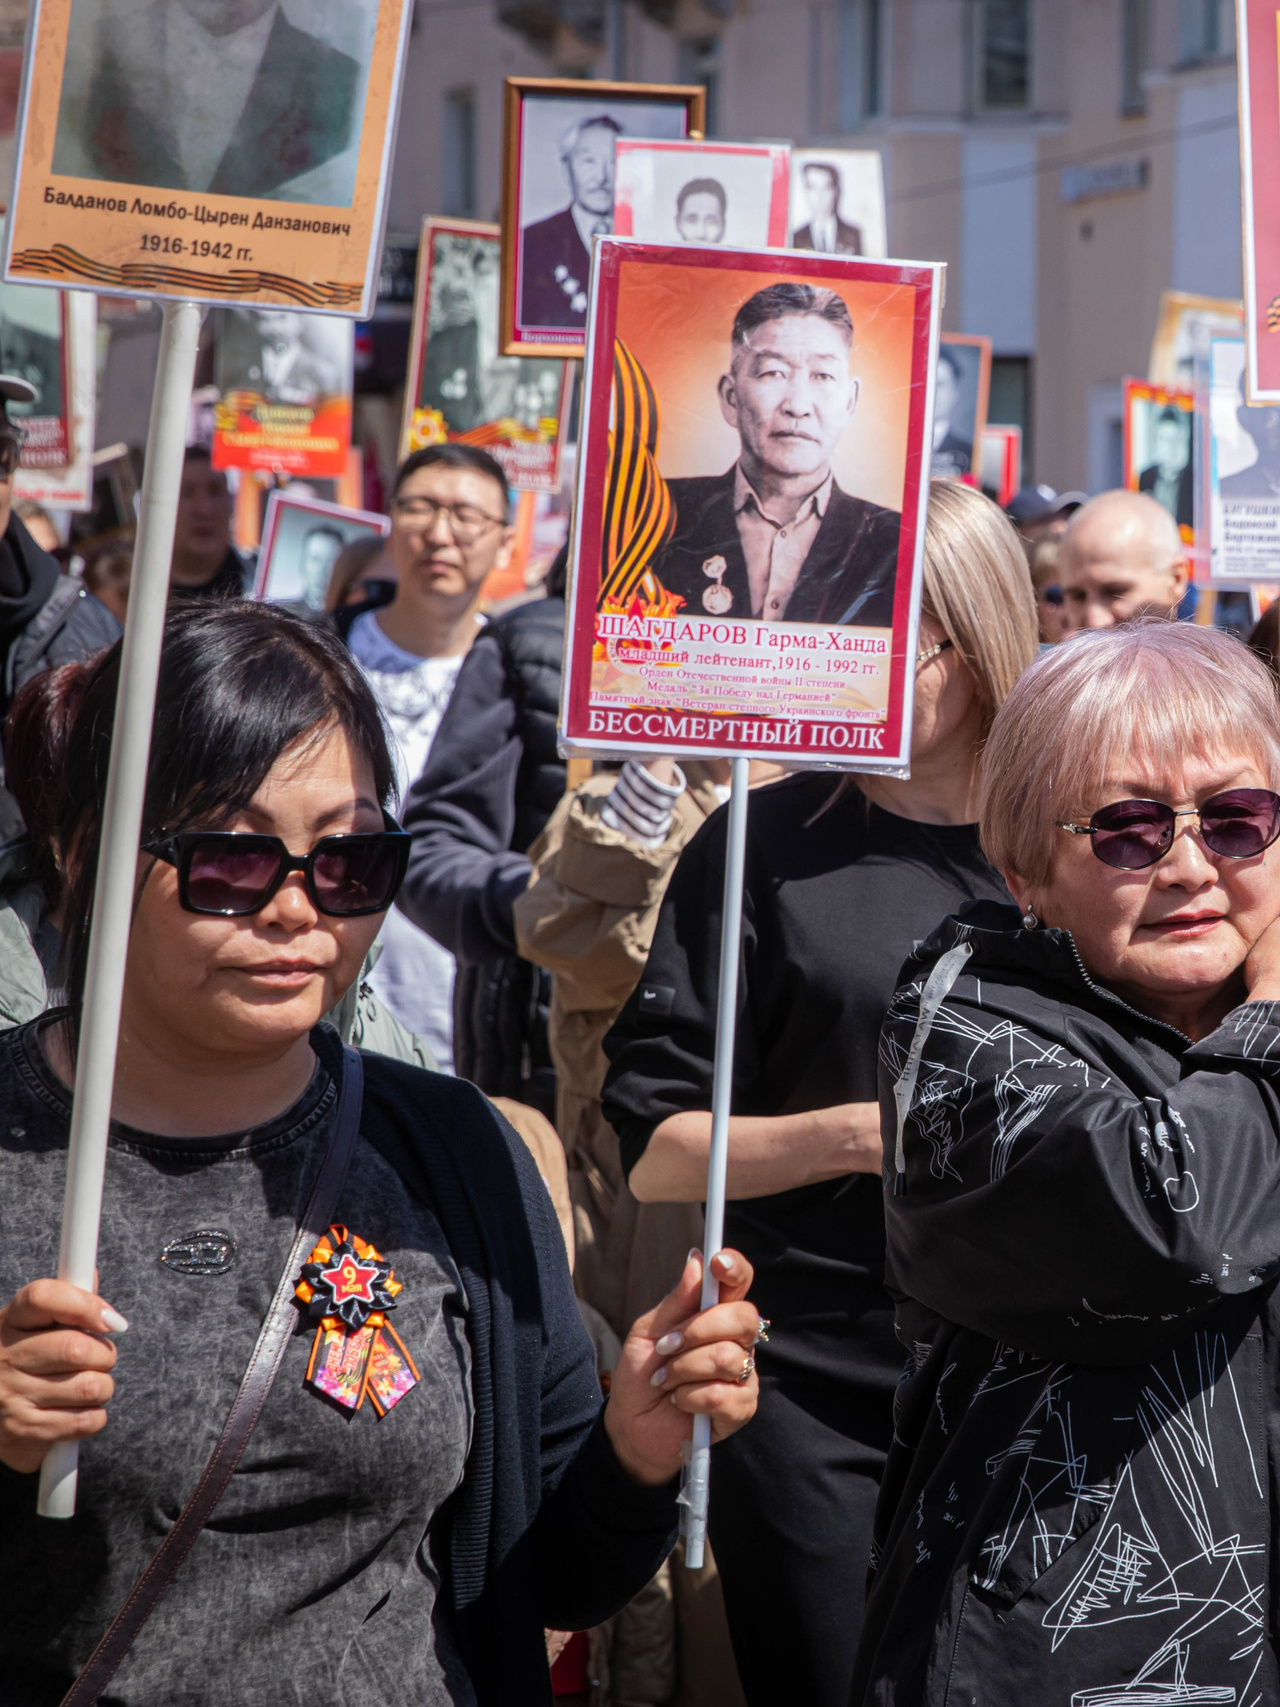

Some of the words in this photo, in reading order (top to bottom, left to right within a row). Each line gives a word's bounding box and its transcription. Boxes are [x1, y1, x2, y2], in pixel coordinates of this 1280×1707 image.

[44, 187, 127, 213] Балданов
[129, 198, 249, 227] Ломбо-Цырен
[251, 212, 351, 237] Данзанович
[139, 234, 232, 260] 1916-1942
[601, 616, 747, 645] ШАГДАРОВ
[755, 626, 887, 654] Гарма-Ханда
[619, 648, 689, 663] младший
[826, 659, 858, 674] 1992
[639, 666, 673, 679] Орден
[676, 668, 757, 684] Отечественной
[761, 675, 791, 686] войны
[806, 680, 846, 690] степени
[647, 681, 688, 694] Медаль
[714, 685, 752, 699] Победу
[756, 691, 773, 701] над
[590, 691, 645, 705] Памятный
[649, 697, 672, 707] знак
[779, 704, 843, 718] Украинского
[588, 709, 803, 746] БЕССМЕРТНЫЙ
[810, 724, 885, 750] ПОЛК
[341, 1284, 363, 1293] мая
[342, 1266, 357, 1285] 9
